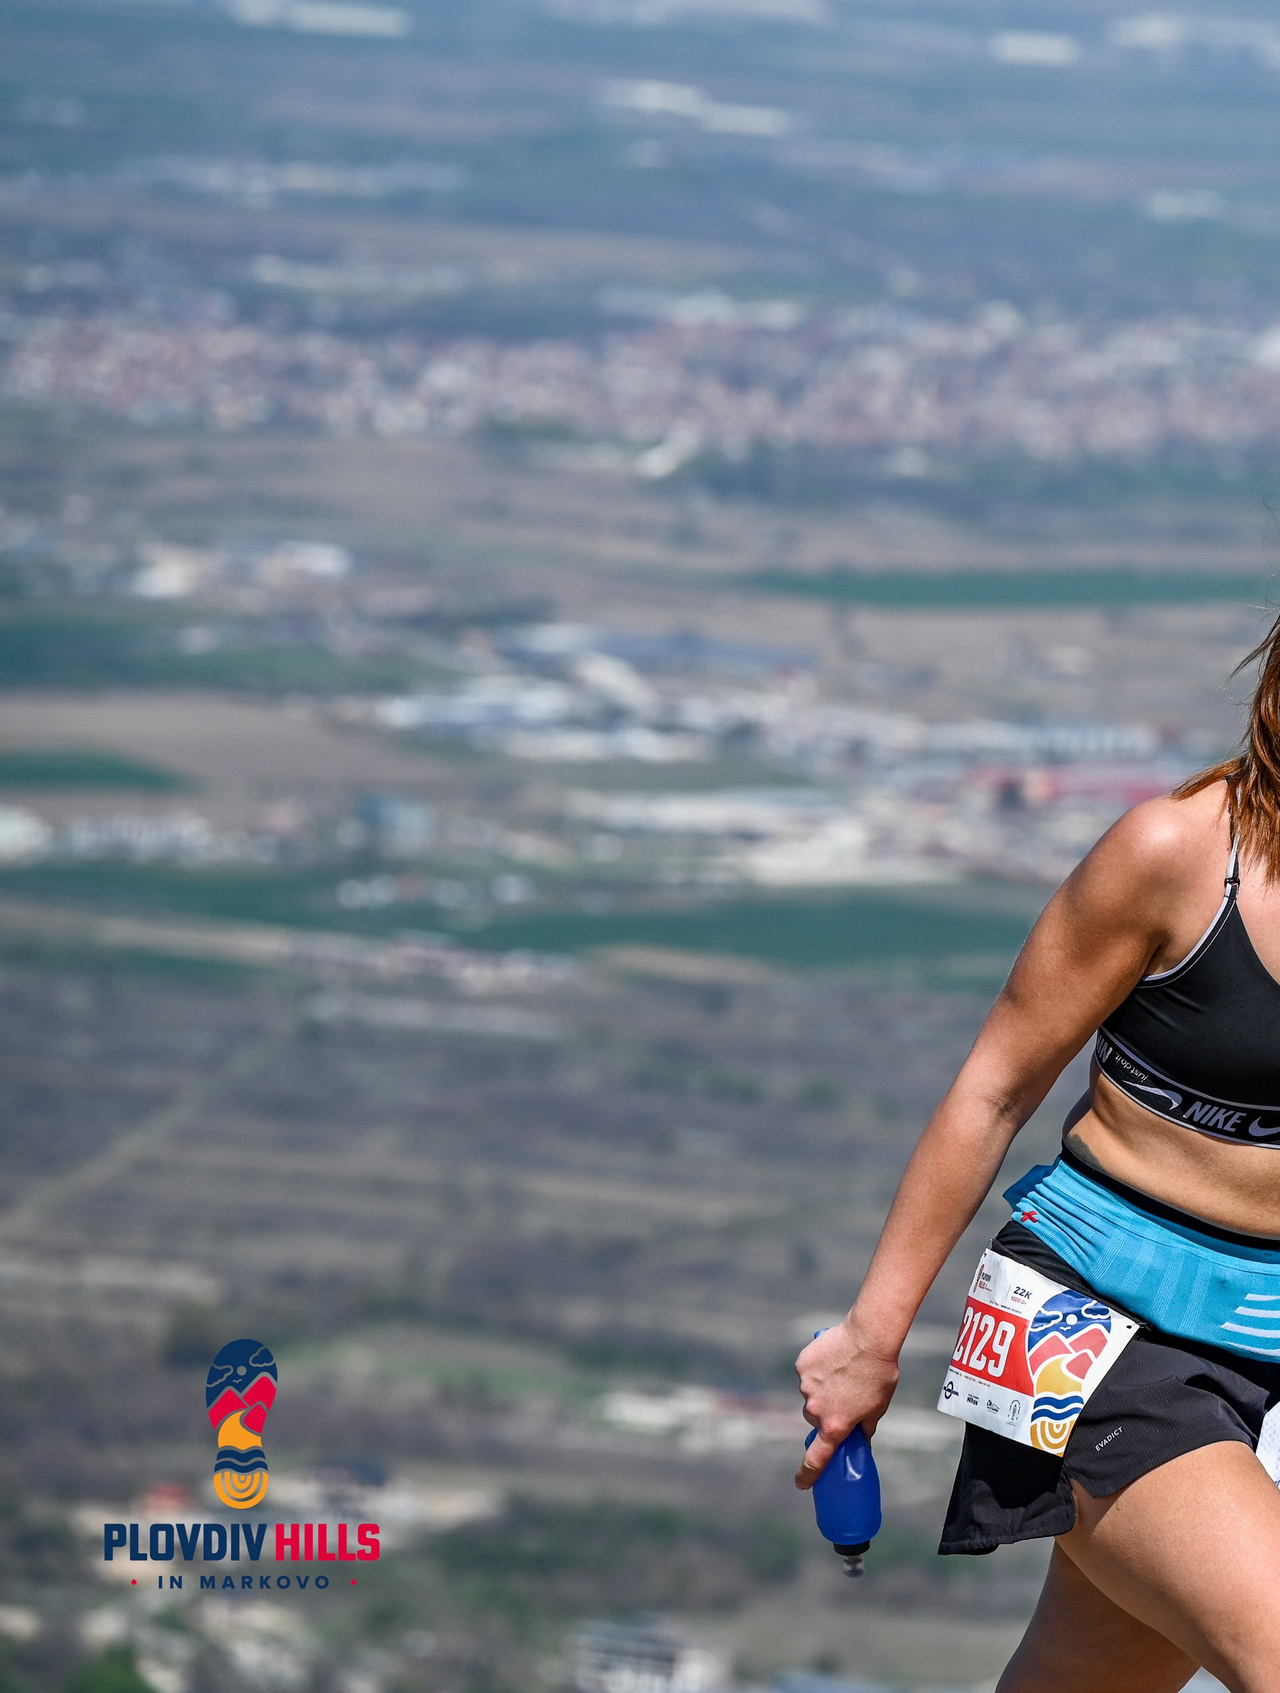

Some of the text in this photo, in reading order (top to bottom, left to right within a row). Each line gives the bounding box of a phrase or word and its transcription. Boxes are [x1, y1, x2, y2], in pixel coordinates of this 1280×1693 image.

[1120, 1058, 1132, 1070] do
[1130, 1066, 1149, 1083] just
[1182, 1100, 1247, 1133] NIKE
[1013, 1286, 1033, 1300] 22K
[952, 1306, 1016, 1378] 2129
[1095, 1426, 1123, 1452] EVADICT
